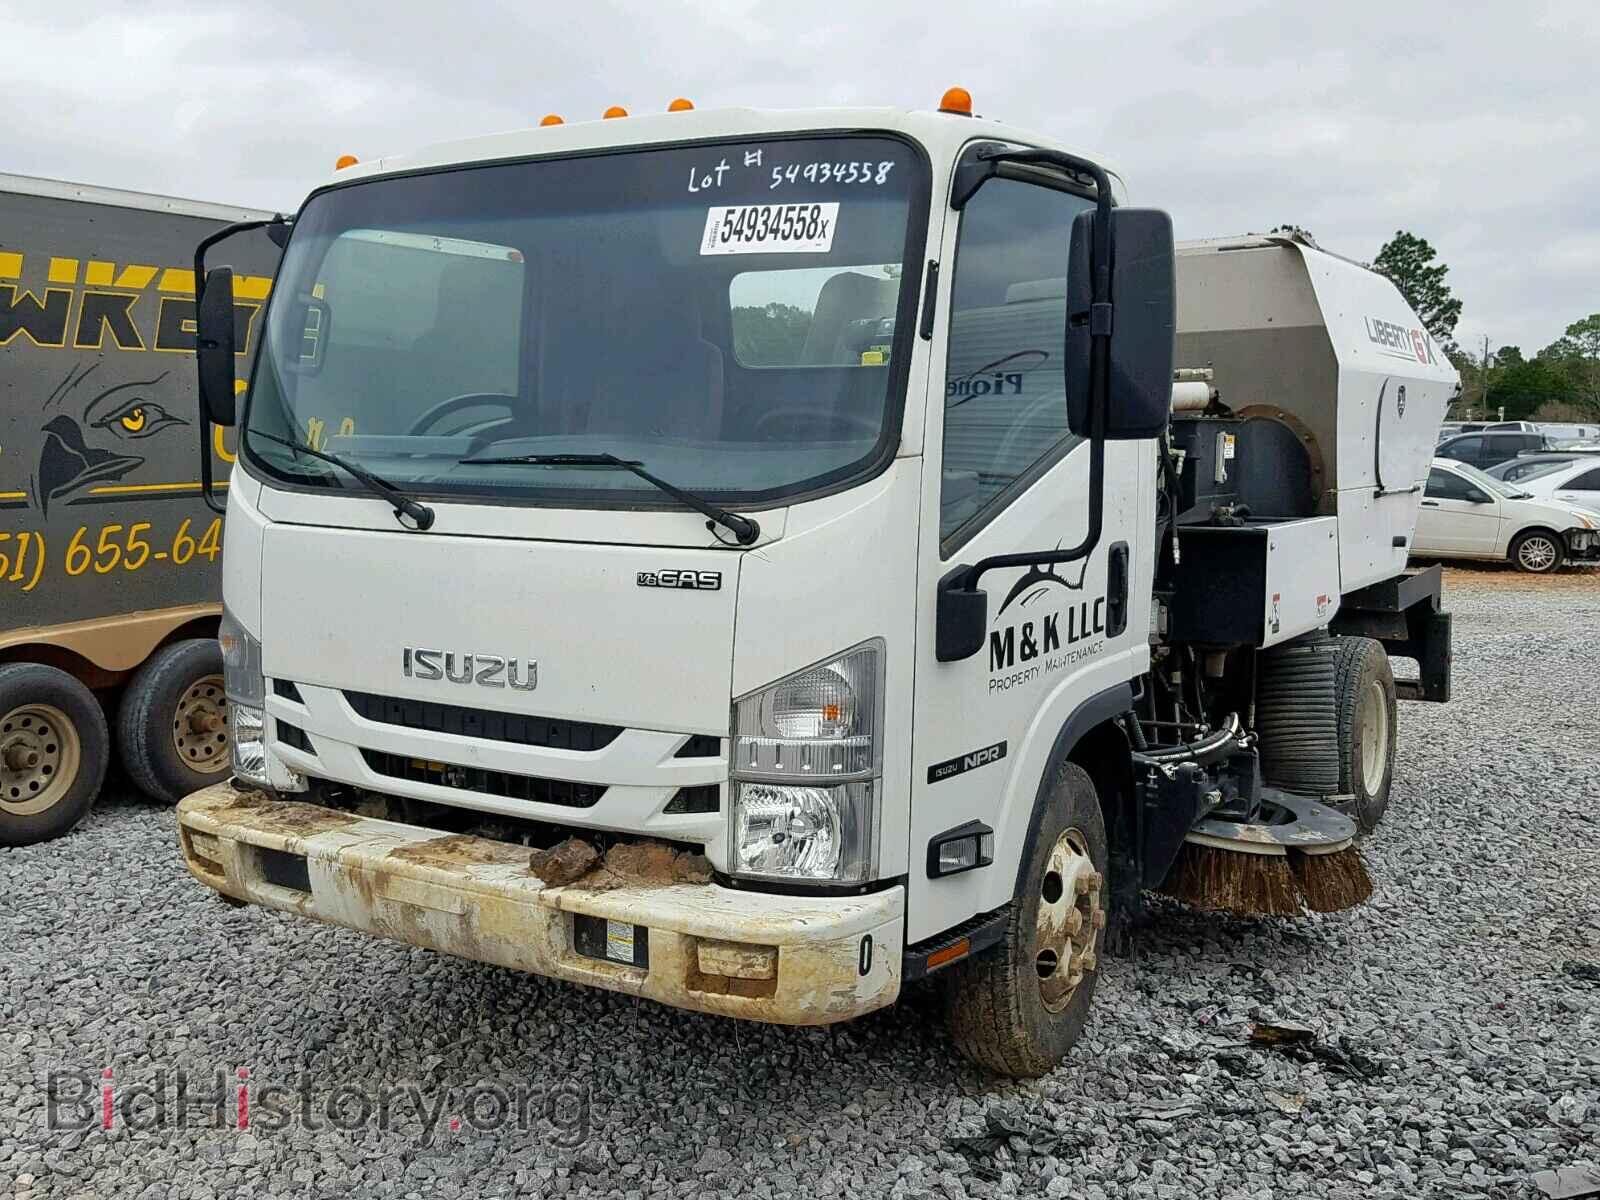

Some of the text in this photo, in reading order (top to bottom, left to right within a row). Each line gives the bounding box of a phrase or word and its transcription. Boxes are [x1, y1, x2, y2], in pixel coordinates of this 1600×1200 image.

[687, 148, 896, 193] Lot # 54934558
[65, 517, 223, 576] 655-64
[657, 570, 719, 589] GAS
[989, 596, 1105, 672] M & K LLC
[402, 646, 538, 691] ISUZU
[989, 640, 1104, 696] PROPERTY MAINTENANCE
[964, 746, 1000, 770] NPR
